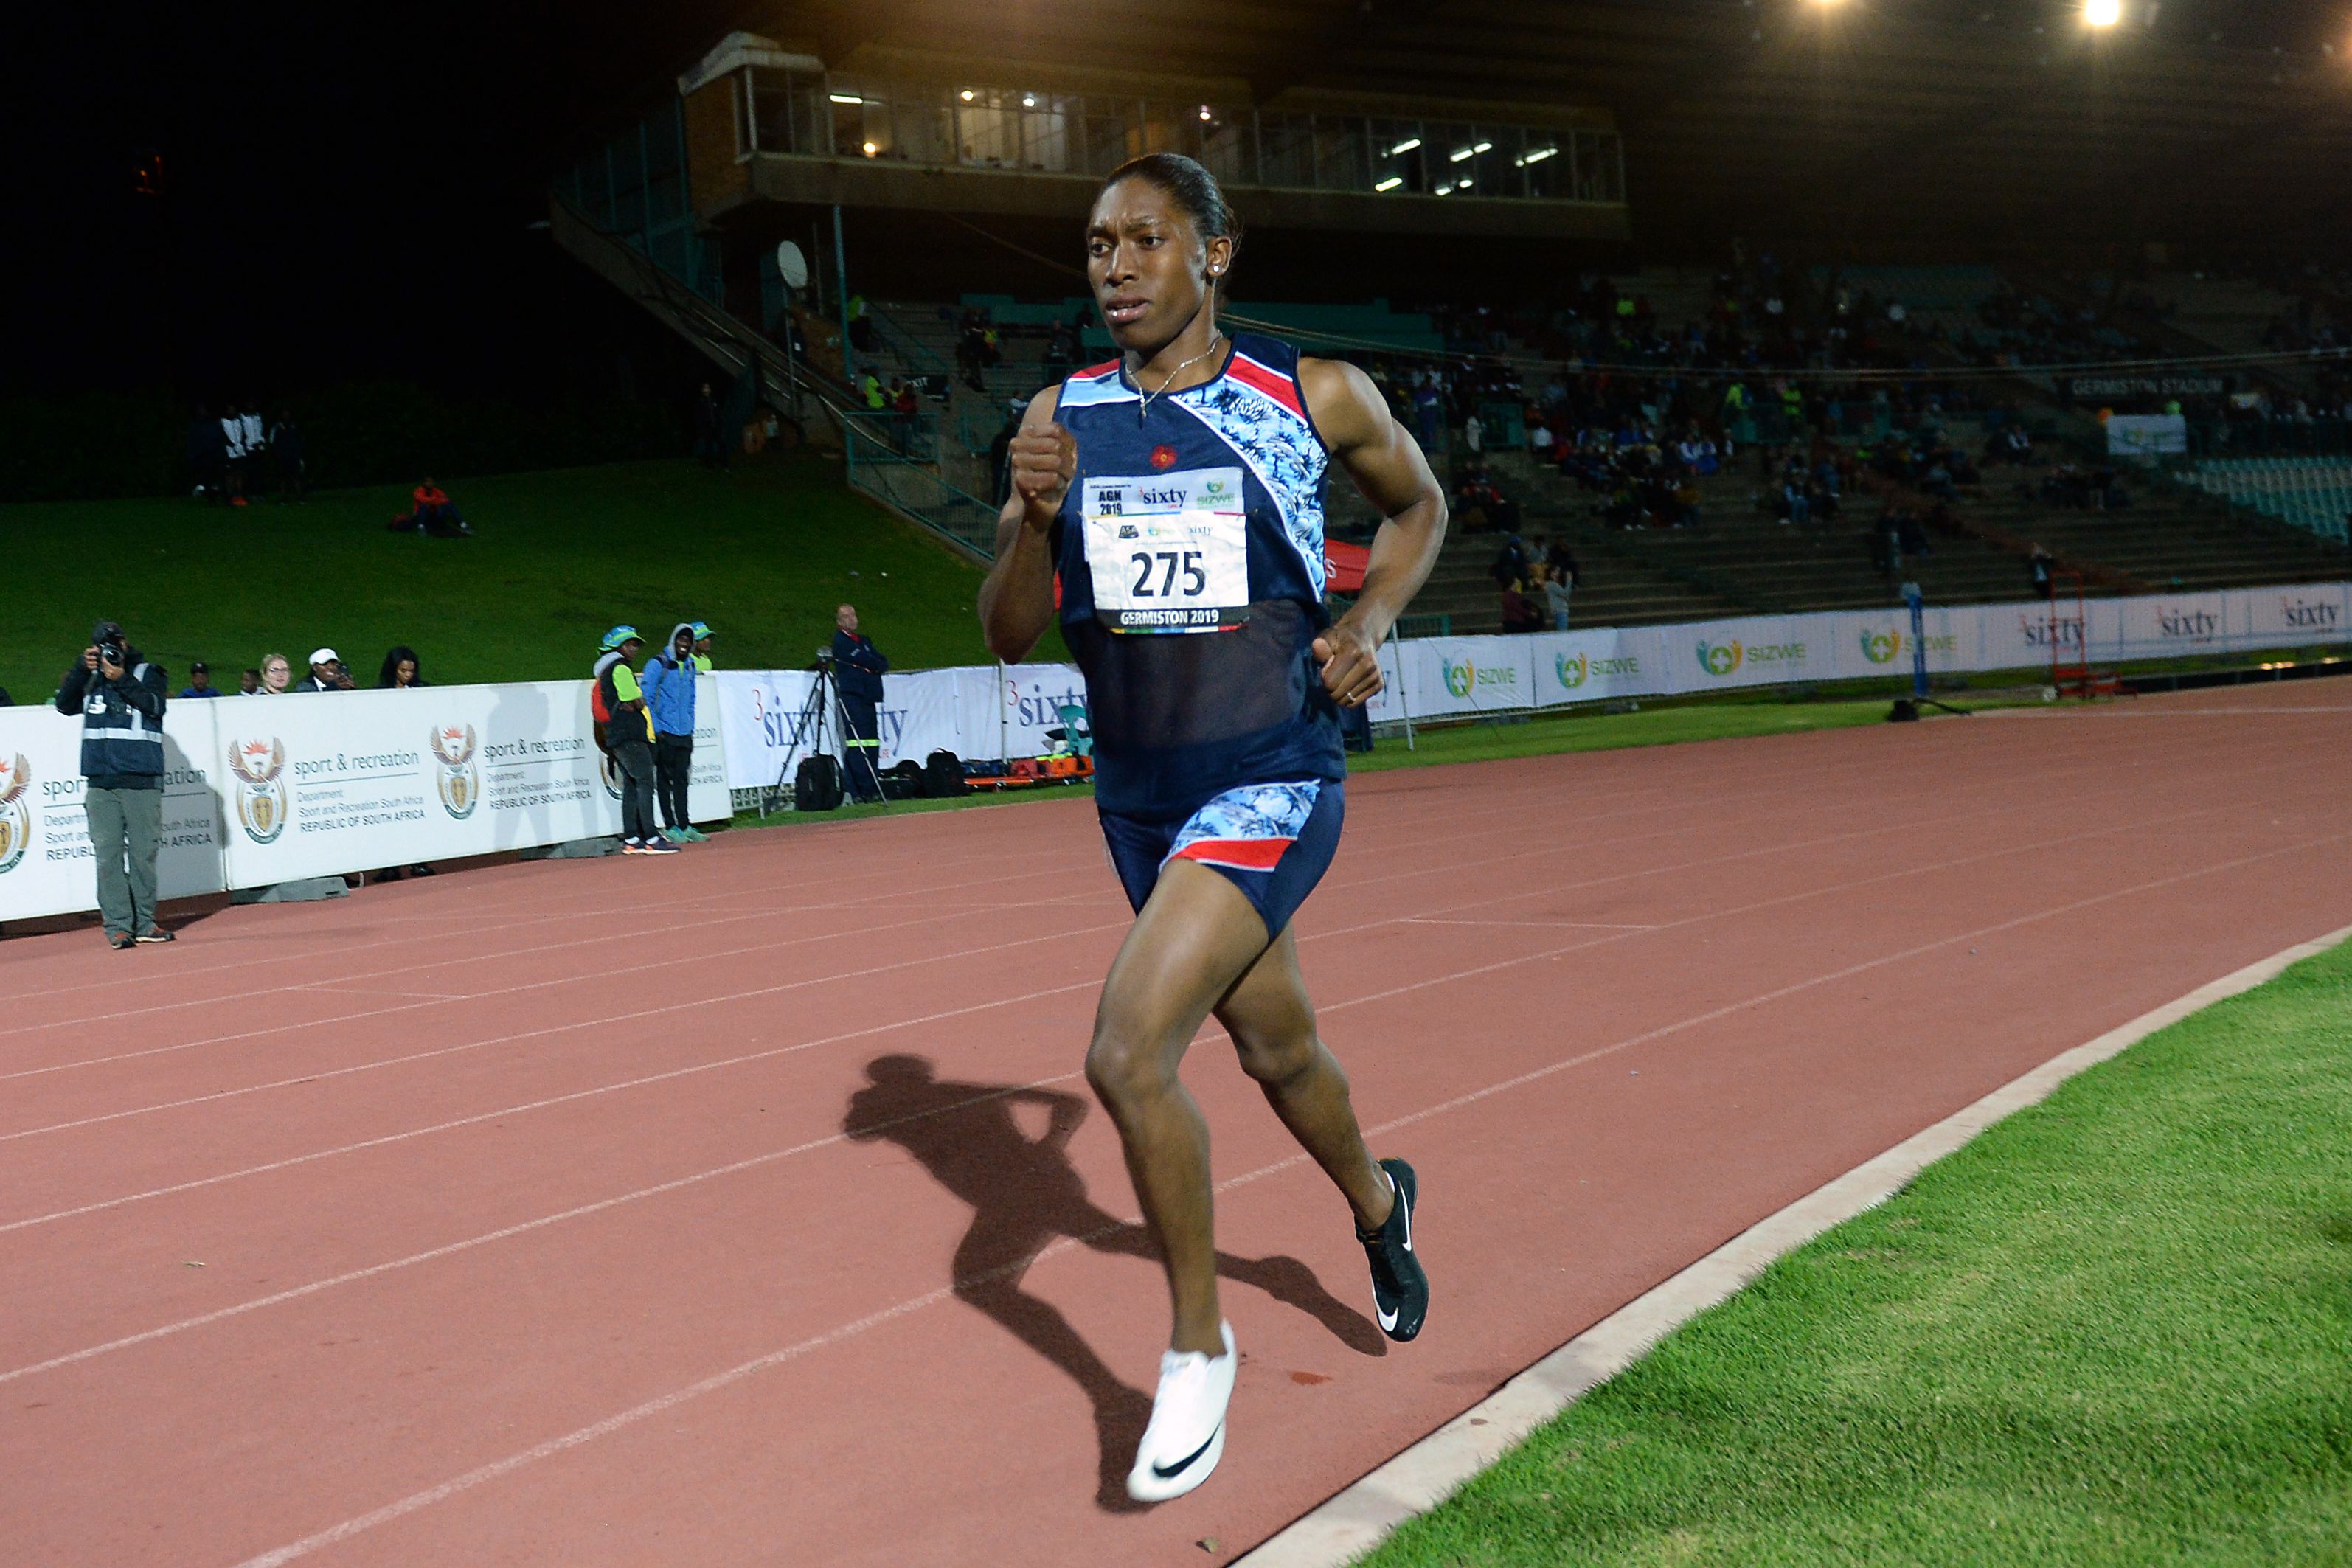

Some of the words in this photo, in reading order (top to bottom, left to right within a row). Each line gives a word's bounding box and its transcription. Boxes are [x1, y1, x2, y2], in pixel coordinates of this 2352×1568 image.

[1098, 490, 1122, 502] AGN
[1196, 495, 1235, 505] SIZWE
[1100, 503, 1123, 515] 2019
[1131, 552, 1206, 597] 275
[1120, 611, 1188, 625] GERMISTON
[1190, 609, 1219, 622] 2019
[1746, 644, 1806, 662] SIZWE
[1589, 657, 1639, 675] SIZWE
[1477, 667, 1516, 685] SIZWE
[484, 743, 516, 763] sport
[518, 739, 527, 754] &
[530, 737, 585, 754] recreation
[294, 758, 333, 779] sport
[337, 753, 347, 770] &
[353, 749, 419, 769] recreation
[43, 778, 88, 802] spor
[490, 797, 527, 810] REPUBLIC
[566, 789, 592, 799] AFRICA
[300, 818, 345, 832] REPUBLIC
[347, 816, 359, 827] OF
[362, 814, 392, 825] SOUTH
[395, 809, 426, 821] AFRICA
[46, 845, 97, 861] REPUBL
[172, 833, 212, 847] AFRICA
